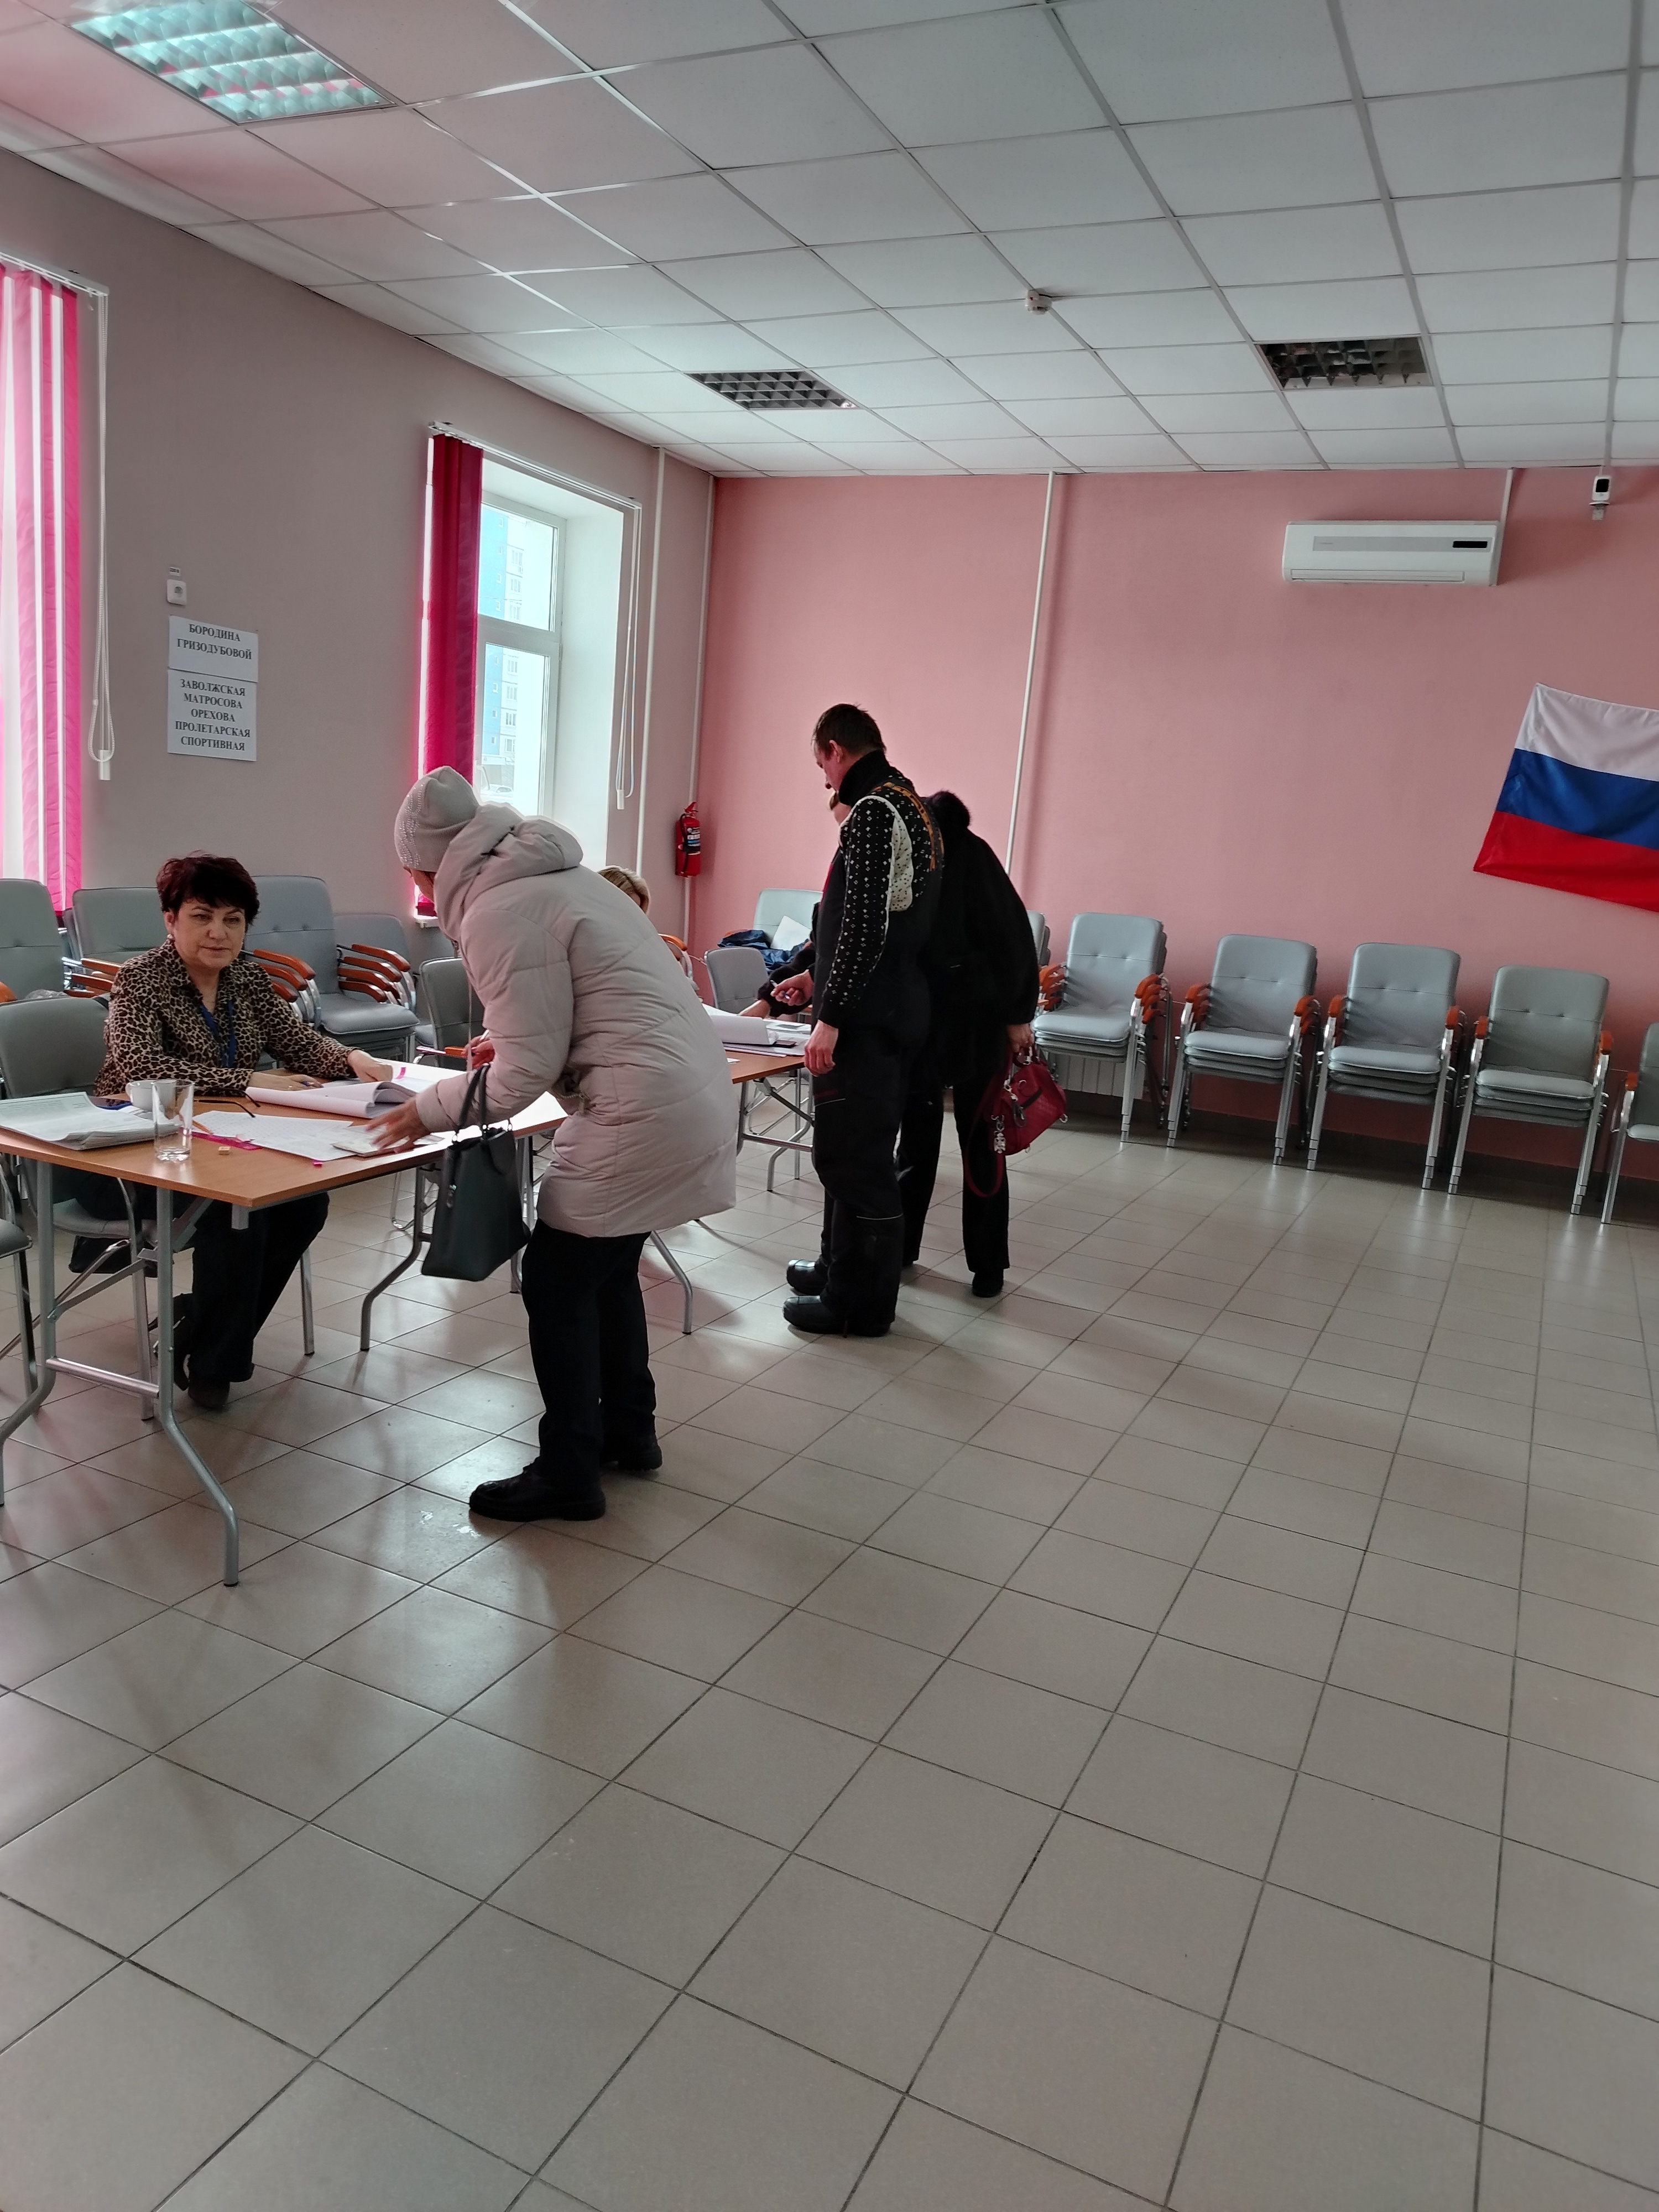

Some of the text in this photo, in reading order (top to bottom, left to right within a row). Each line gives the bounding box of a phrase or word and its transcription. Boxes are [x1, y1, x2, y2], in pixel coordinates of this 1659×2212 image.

[189, 624, 241, 641] БОРОДИНА
[177, 638, 252, 659] ГРИЗОДУБОВОЙ
[180, 679, 246, 696] ЗАВОЛЖСКАЯ
[184, 693, 242, 708] МАТРОСОВА
[191, 708, 236, 722] ОРЕХОВА
[175, 721, 251, 737] ПРОЛЕТАРСКАЯ
[181, 736, 245, 750] СПОРТИВНАЯ
